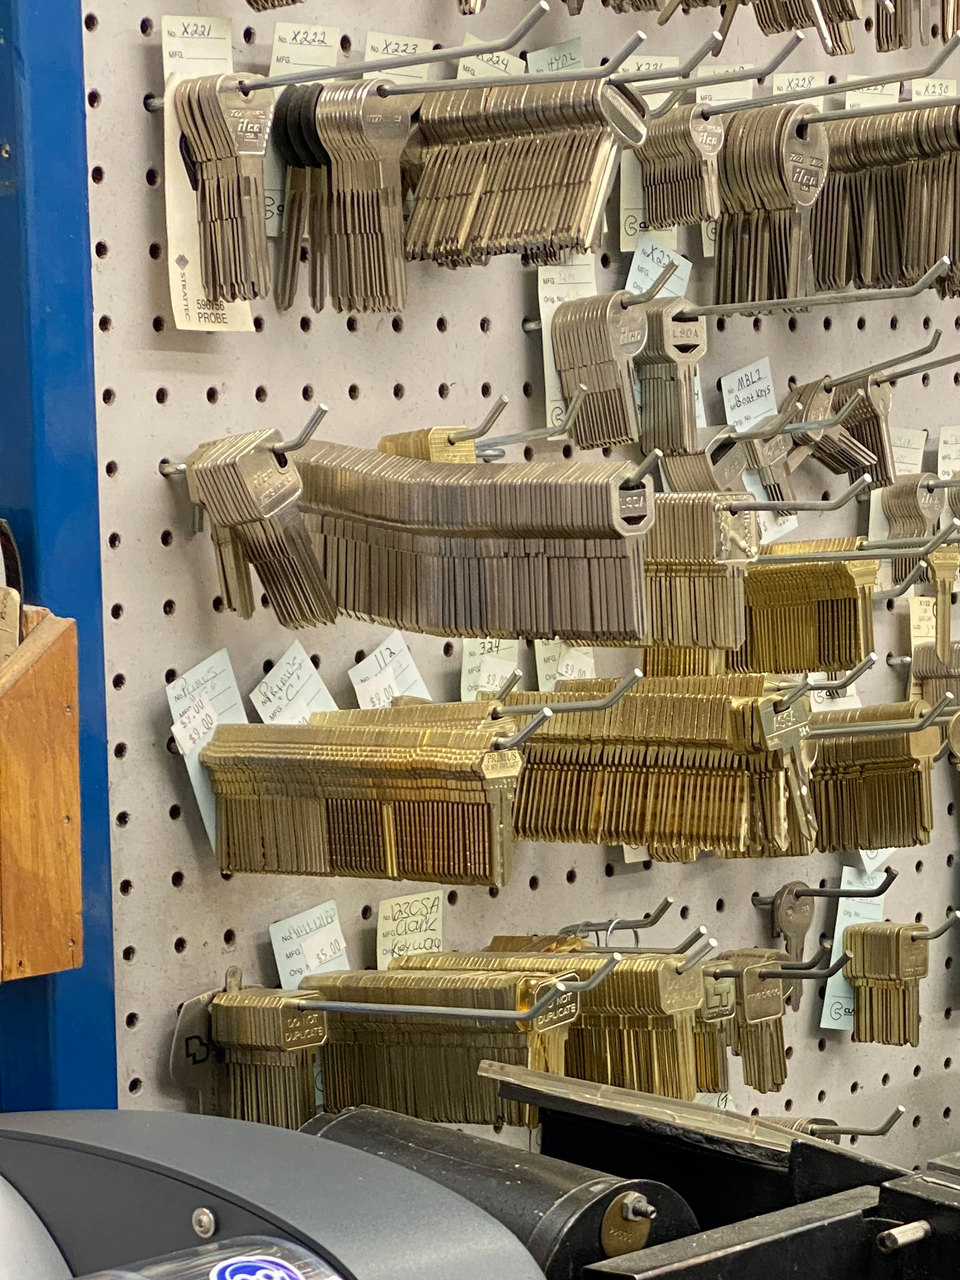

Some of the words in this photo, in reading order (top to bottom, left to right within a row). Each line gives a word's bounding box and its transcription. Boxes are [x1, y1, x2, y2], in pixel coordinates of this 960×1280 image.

[181, 22, 212, 37] X221
[292, 31, 327, 45] X222
[382, 40, 419, 55] X223
[198, 312, 228, 324] PROBE
[479, 641, 500, 656] 324
[487, 751, 517, 763] PRIMUS
[316, 938, 341, 964] $5.00
[556, 992, 573, 1004] NOT
[538, 1004, 576, 1025] DUPLICATE
[287, 1018, 300, 1028] DO
[285, 1026, 323, 1042] DUPLICATE
